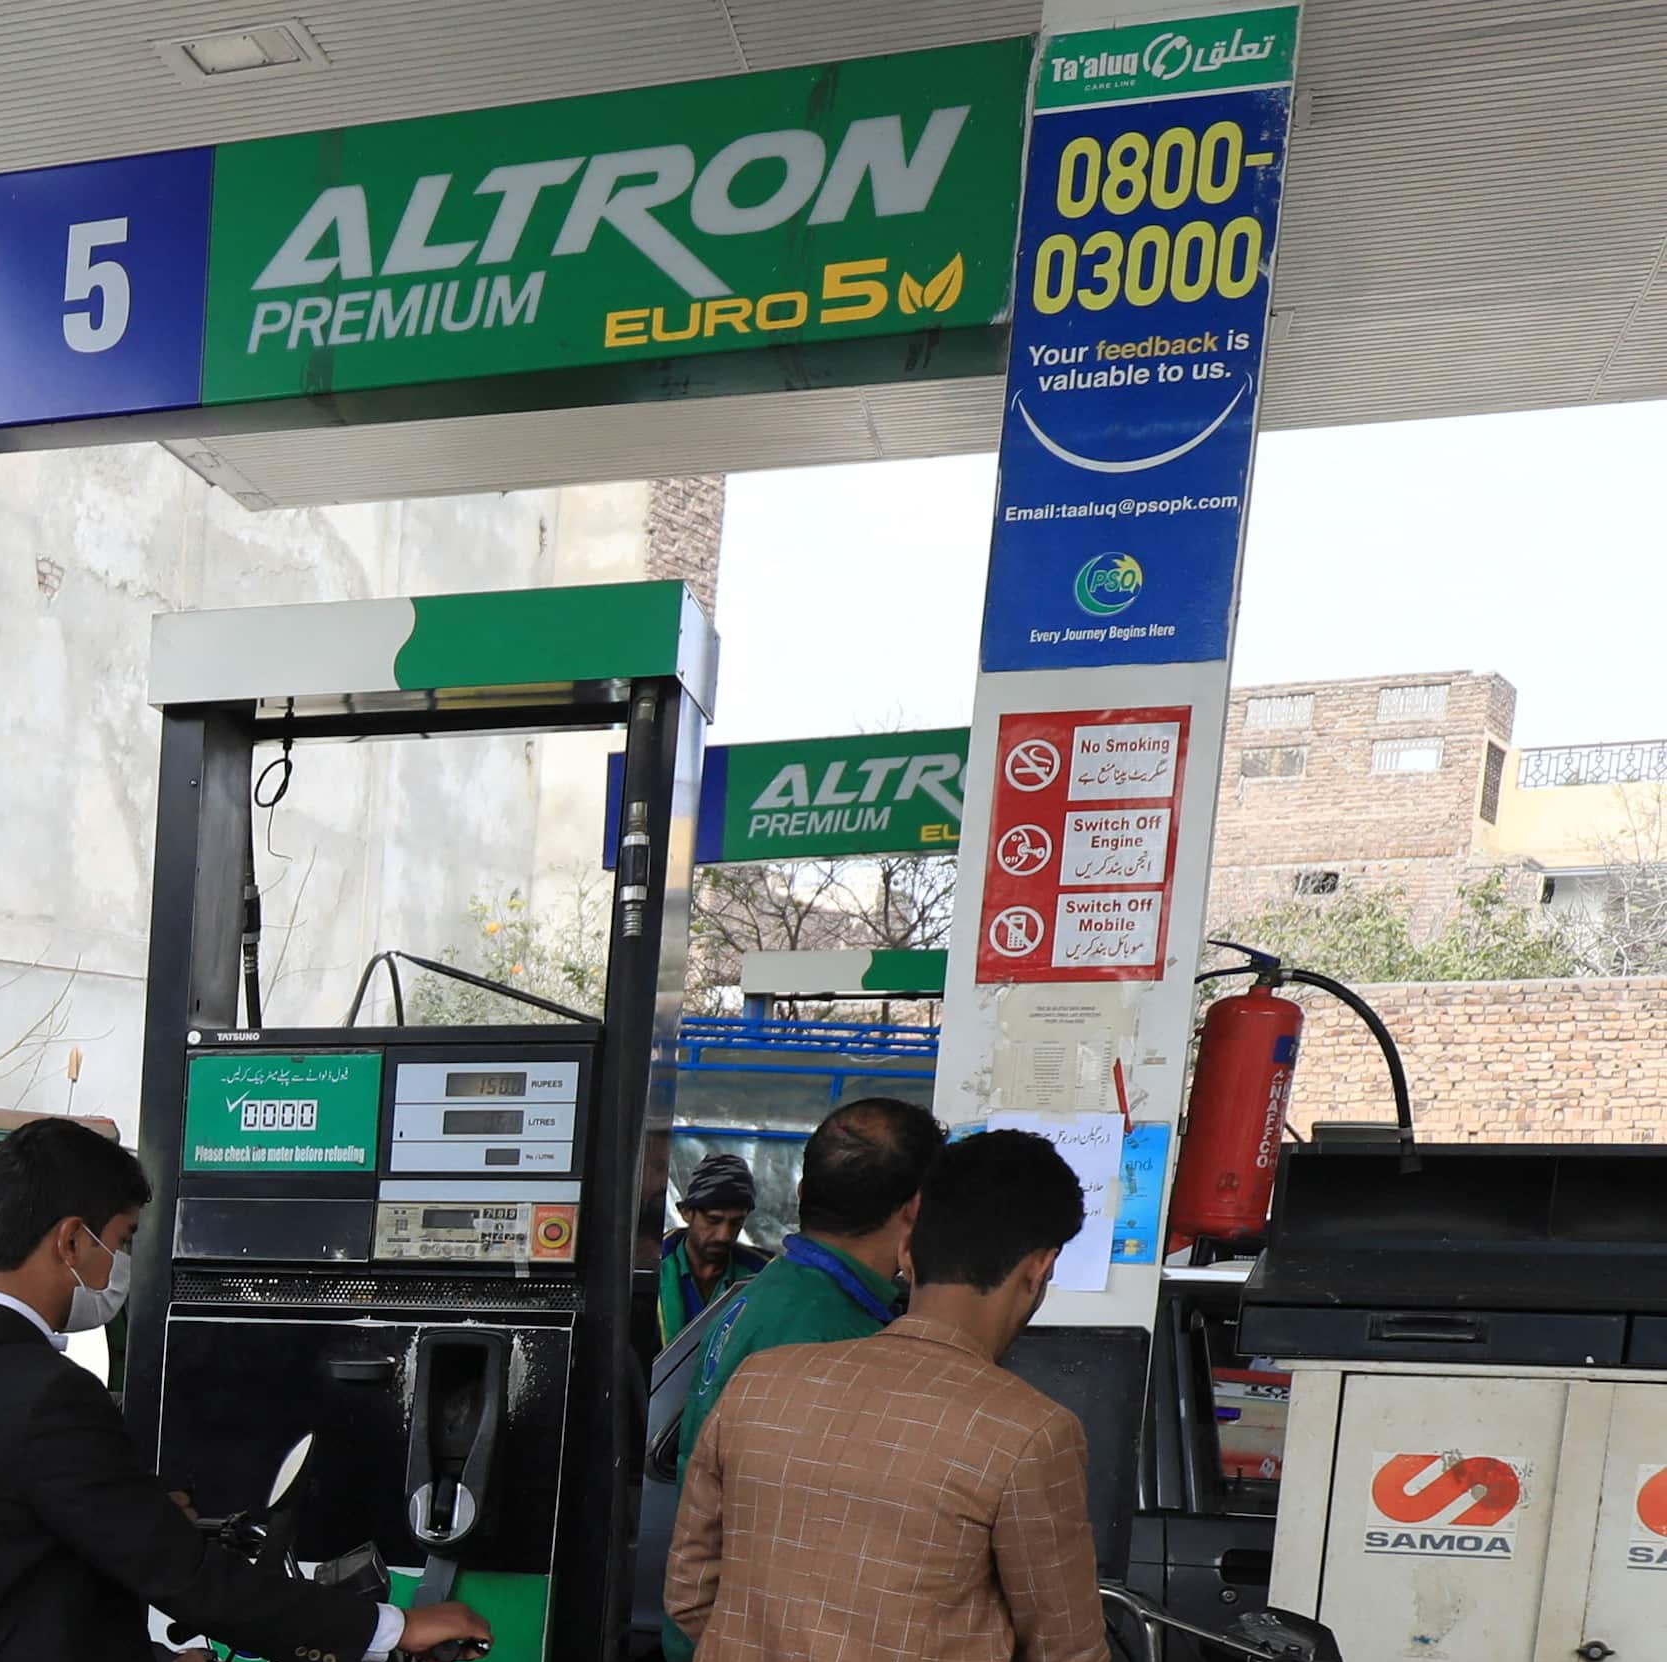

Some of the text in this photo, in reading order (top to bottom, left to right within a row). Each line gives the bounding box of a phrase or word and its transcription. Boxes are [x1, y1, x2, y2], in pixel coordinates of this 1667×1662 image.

[1051, 52, 1139, 82] Ta'aluq
[1084, 80, 1136, 91] CARE LINE
[1056, 121, 1274, 219] 0800-
[253, 106, 970, 298] ALTRON
[1033, 216, 1263, 315] 03000
[62, 217, 130, 354] 5
[248, 271, 546, 356] PREMIUM
[1029, 329, 1250, 367] Your feedback is
[1038, 360, 1232, 393] valuable to us.
[1005, 495, 1238, 522] Email:taaluq@psopk.com
[1090, 569, 1137, 593] PSO
[1029, 623, 1176, 644] Every Journey Begins Here
[1081, 738, 1170, 754] No Smoking
[750, 752, 965, 825] ALTR
[747, 806, 892, 839] PREMIUM
[1073, 815, 1163, 832] Switch Off
[1091, 834, 1144, 850] Engine
[1005, 855, 1019, 864] Off
[1065, 898, 1154, 914] Switch Off
[1079, 918, 1136, 932] Mobile
[217, 1032, 260, 1041] TATSUNO
[531, 1079, 564, 1089] RUPEES
[244, 1103, 315, 1128] 0000
[528, 1118, 556, 1127] LITRES
[195, 1145, 223, 1162] Please
[224, 1145, 251, 1162] check
[252, 1145, 266, 1162] the
[267, 1145, 294, 1162] meter
[295, 1145, 323, 1162] before
[1365, 1532, 1511, 1553] SAMOA
